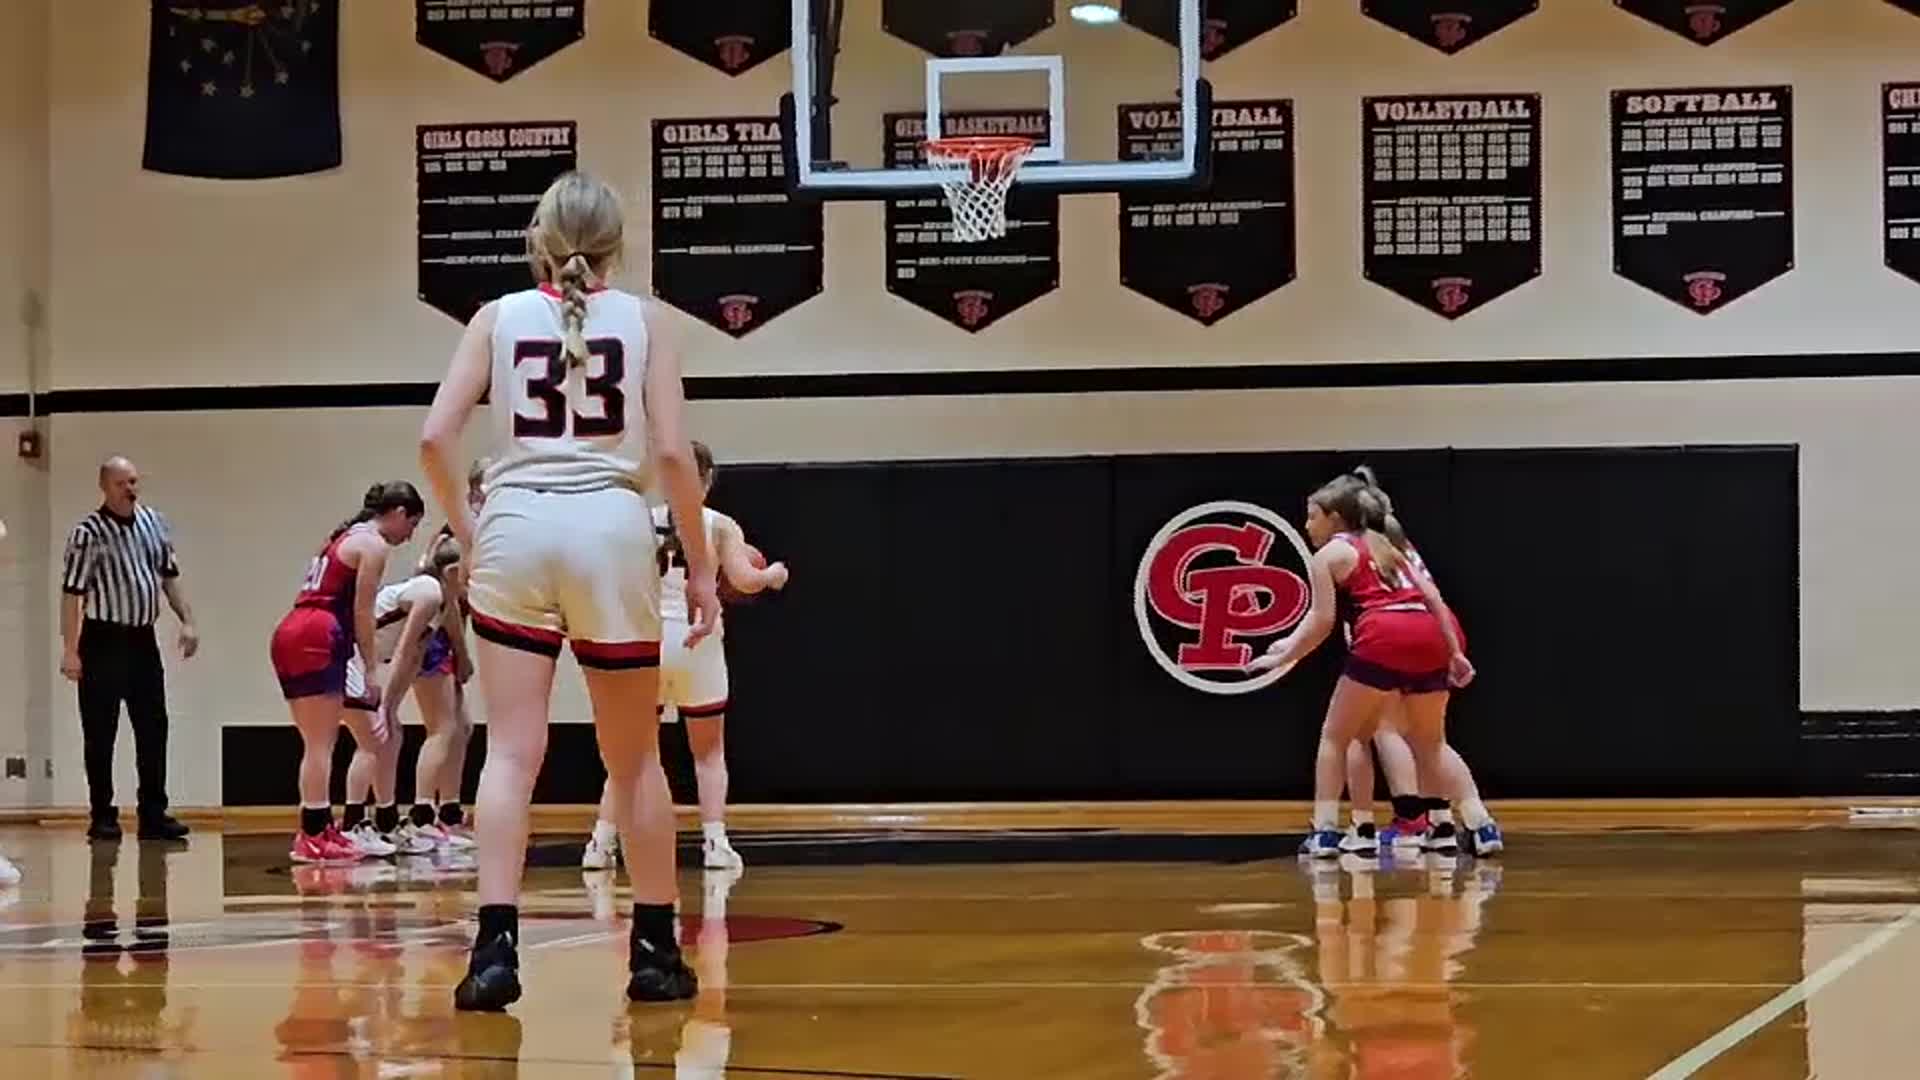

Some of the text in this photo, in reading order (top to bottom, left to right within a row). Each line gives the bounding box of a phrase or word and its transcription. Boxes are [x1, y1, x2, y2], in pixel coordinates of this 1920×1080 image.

[1374, 101, 1531, 121] VOLLEYBALL
[1626, 93, 1778, 114] SOFTBALL
[946, 116, 1046, 135] BASKETBALL
[1129, 107, 1283, 129] VOLBALL
[423, 127, 570, 149] GIRLS CROSS COUNTRY
[663, 123, 782, 143] GIRLS TRA
[512, 336, 625, 440] 33
[1147, 522, 1310, 673] CP
